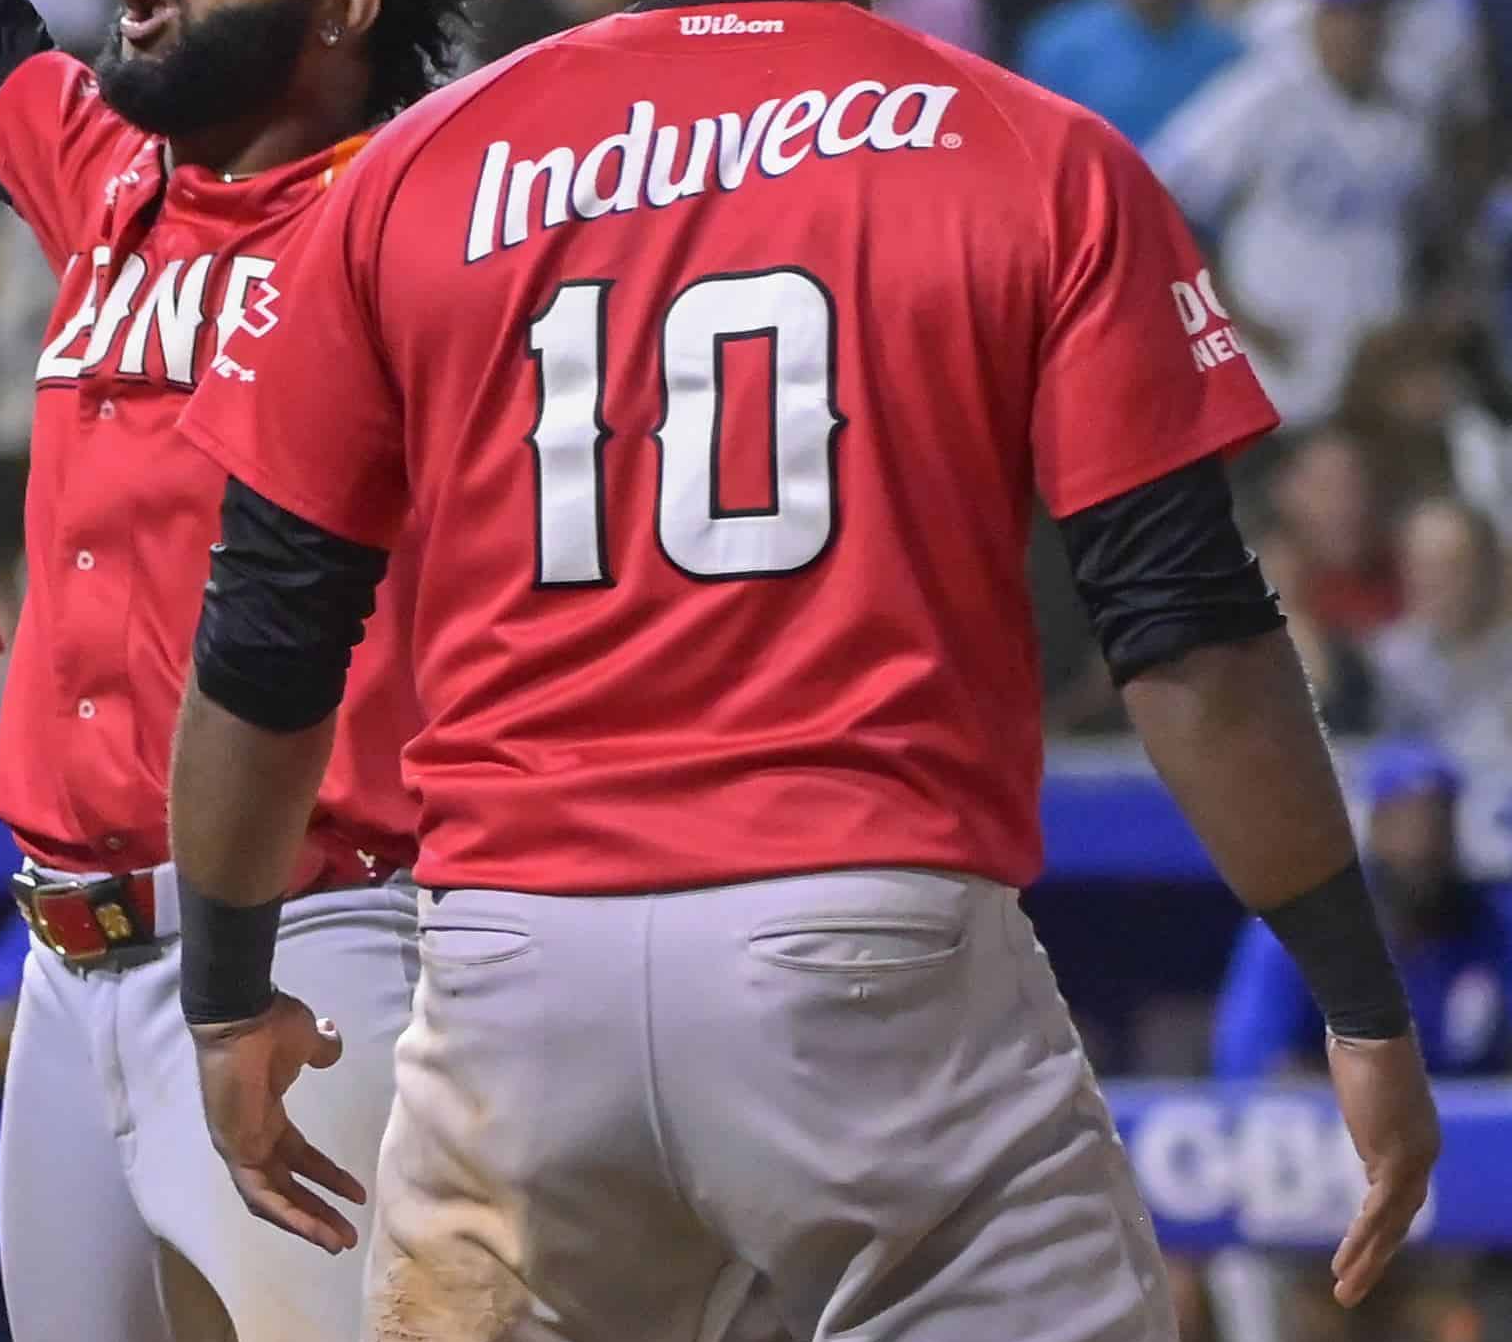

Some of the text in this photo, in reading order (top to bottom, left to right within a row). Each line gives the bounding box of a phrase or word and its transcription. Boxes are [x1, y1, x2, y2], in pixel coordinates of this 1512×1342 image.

[679, 13, 785, 36] Wilson
[465, 80, 959, 263] Induveca
[522, 264, 848, 591] 10
